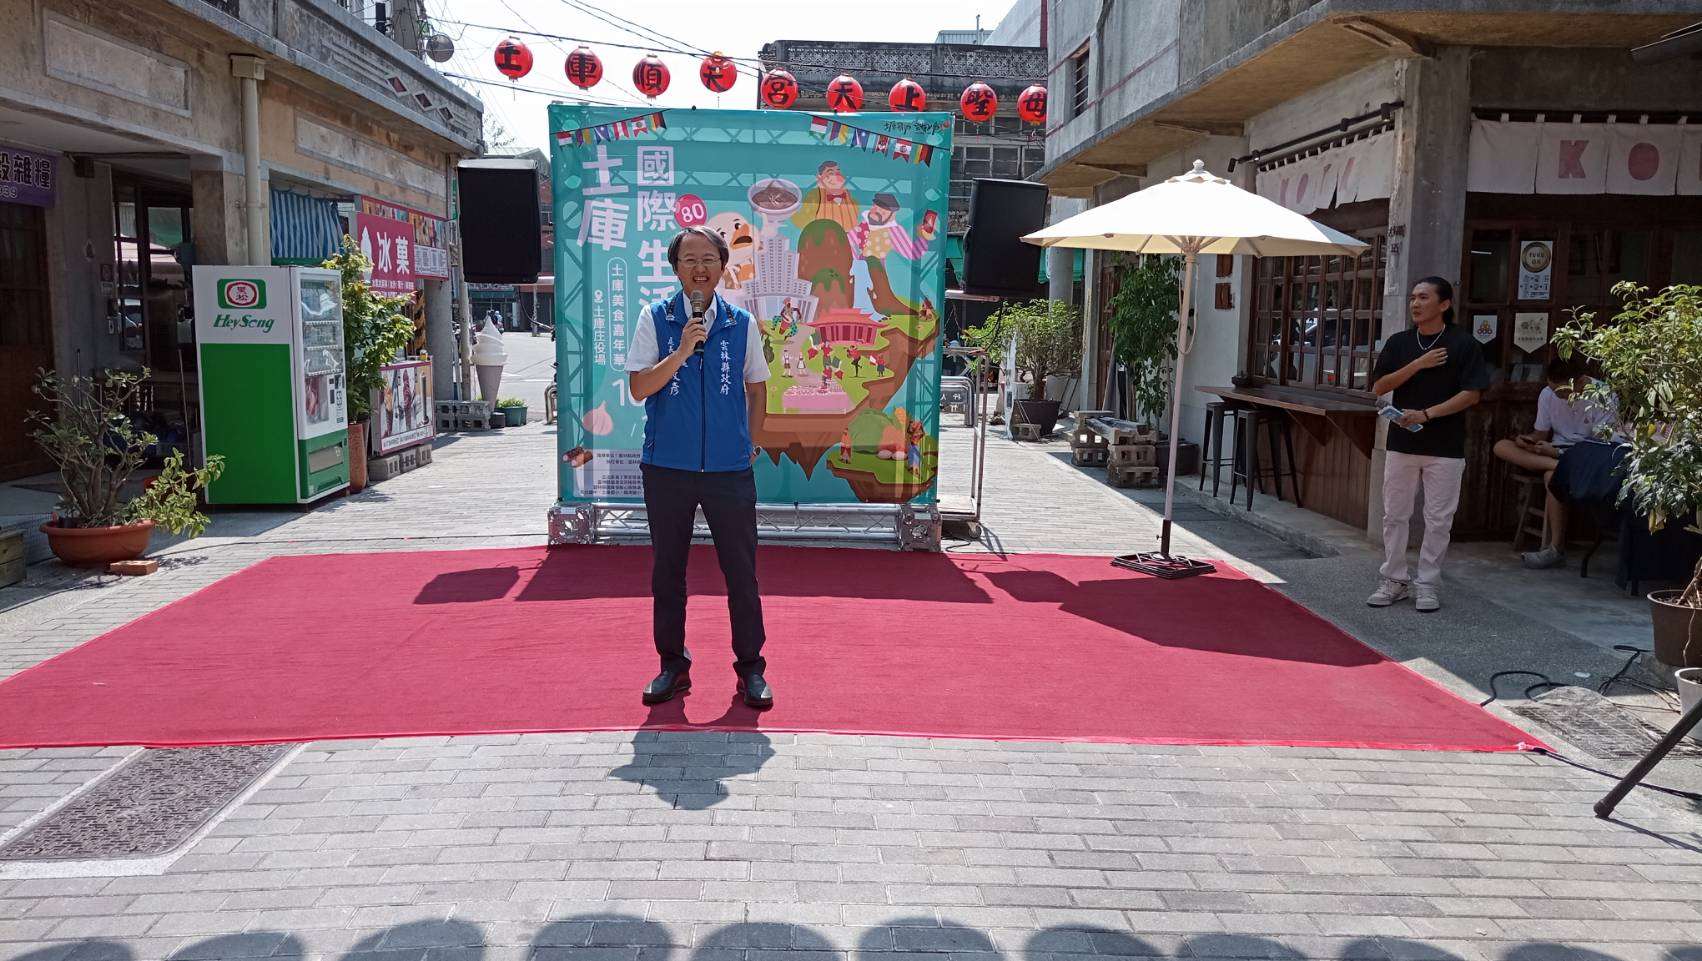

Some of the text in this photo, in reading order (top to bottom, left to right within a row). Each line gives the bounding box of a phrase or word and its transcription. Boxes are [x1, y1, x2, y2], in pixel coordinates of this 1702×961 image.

[577, 144, 630, 252] 土庫
[681, 203, 705, 223] 80
[376, 231, 411, 275] 冰菓
[213, 313, 275, 334] HeySong
[611, 263, 626, 366] 土庫美食嘉年華
[720, 340, 735, 396] 雲林縣政府
